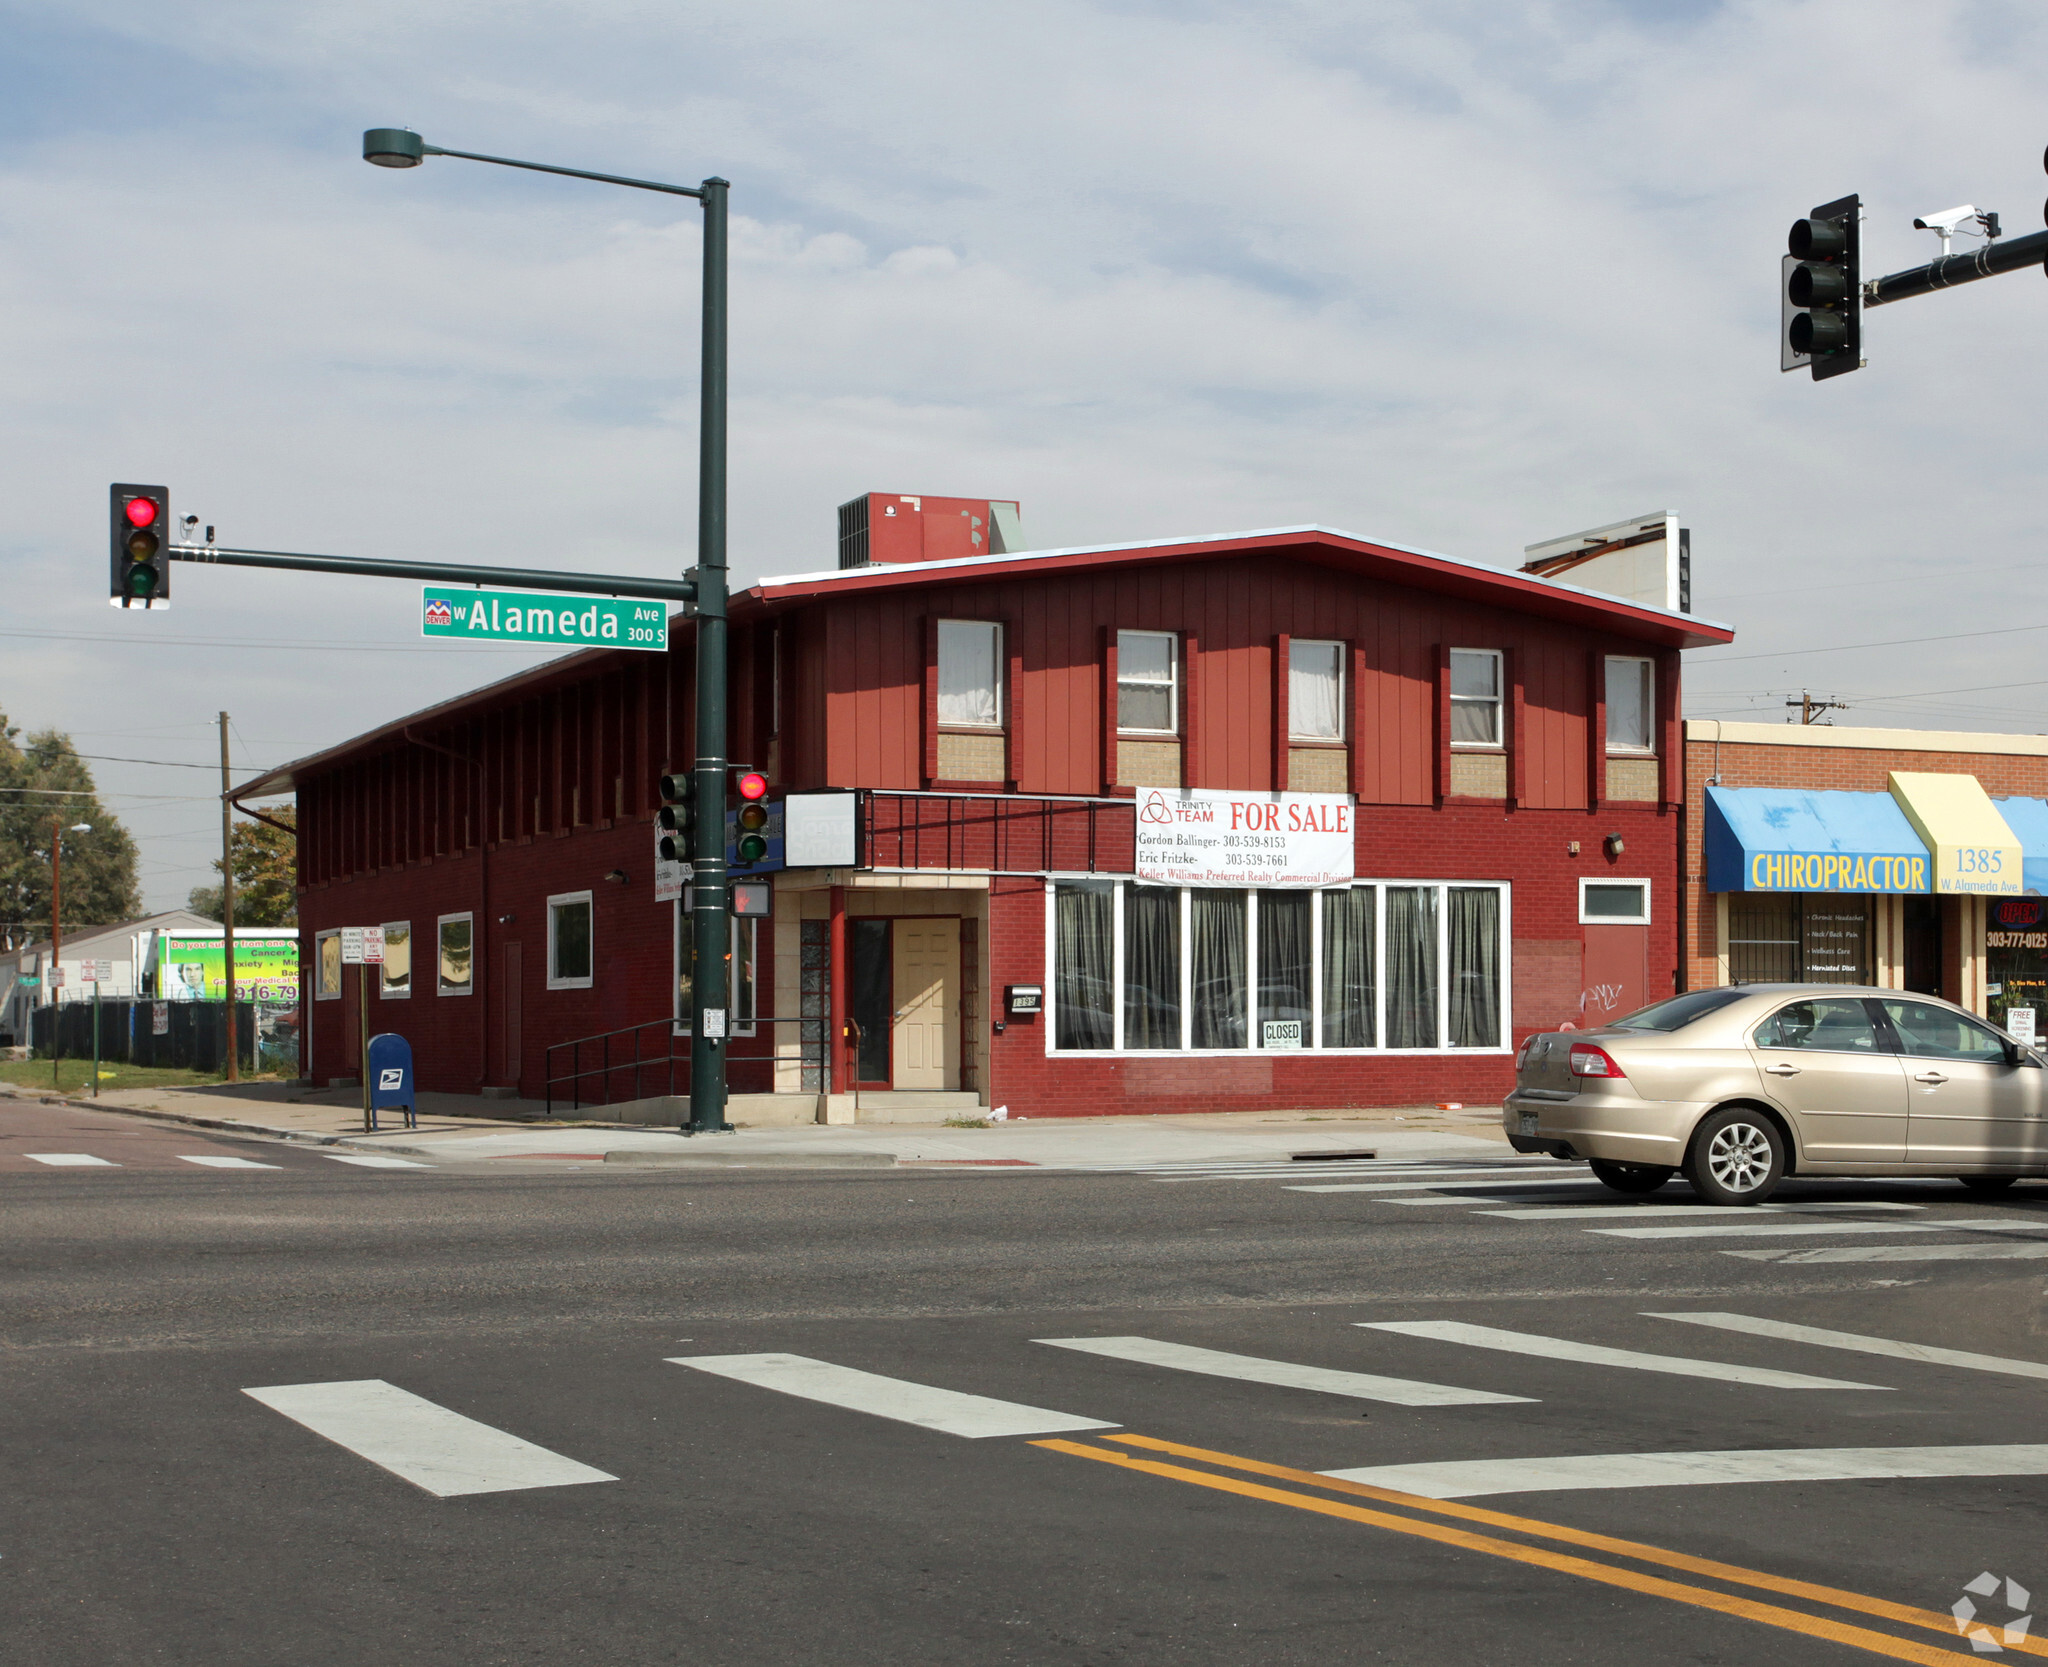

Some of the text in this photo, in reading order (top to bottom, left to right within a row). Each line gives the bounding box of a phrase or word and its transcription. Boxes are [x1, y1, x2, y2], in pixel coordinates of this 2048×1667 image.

[427, 615, 451, 626] DENVER
[468, 599, 618, 639] Alameda
[634, 607, 660, 622] Ave
[628, 627, 665, 643] 300 S
[1175, 801, 1213, 810] TRINITY
[1175, 810, 1214, 823] TEAM
[1230, 802, 1349, 833] FOR SALE
[1138, 832, 1286, 849] Gordon Ballinger- 303-539-8153
[1138, 851, 1288, 867] Eric Fritzke- 303-539-7661
[1956, 848, 2003, 874] 1385
[1138, 867, 1353, 884] Keller Williams Preferred Realty Commercial Division
[1751, 853, 1926, 891] CHIROPRACTOR
[1941, 878, 2020, 893] W. Alameda Ave.
[2000, 902, 2039, 923] OPEN
[1811, 930, 1843, 938] Neck/Back
[1986, 931, 2048, 949] 303-777-0125
[171, 941, 185, 949] Do
[187, 942, 206, 950] you
[241, 940, 265, 948] from
[266, 940, 286, 948] one
[1811, 947, 1835, 955] Wellness
[251, 949, 286, 957] Cancer
[1811, 964, 1840, 972] Herniated
[255, 977, 290, 985] Medical
[1015, 997, 1035, 1006] 1395
[2013, 1010, 2031, 1020] FREE
[1266, 1024, 1299, 1040] CLOSED
